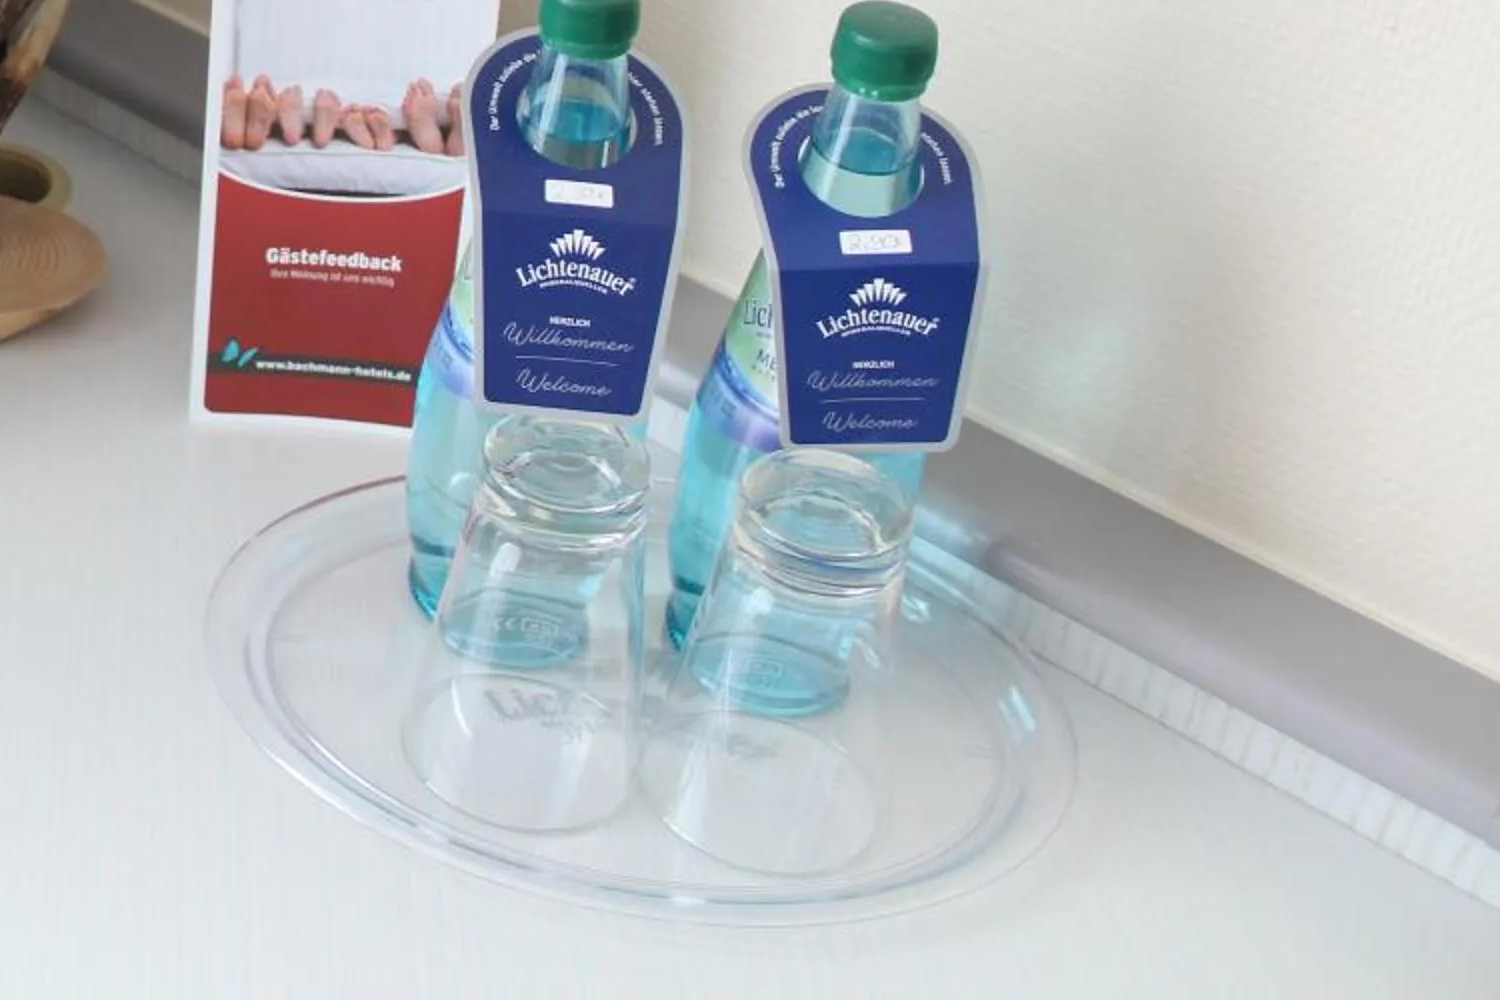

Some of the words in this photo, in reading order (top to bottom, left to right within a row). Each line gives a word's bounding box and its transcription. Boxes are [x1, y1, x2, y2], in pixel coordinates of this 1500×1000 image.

[265, 247, 402, 272] Gästefeedback
[515, 258, 636, 296] Lichtenauer
[548, 315, 592, 329] HERZLICH
[816, 307, 938, 339] Lichtenauer
[503, 320, 635, 353] Willkommen
[255, 359, 412, 382] www.bachmann-hotels.de
[851, 359, 896, 370] HERZLICH
[515, 367, 613, 396] Welcome
[806, 369, 940, 393] Willkommen
[821, 411, 919, 433] Welcome
